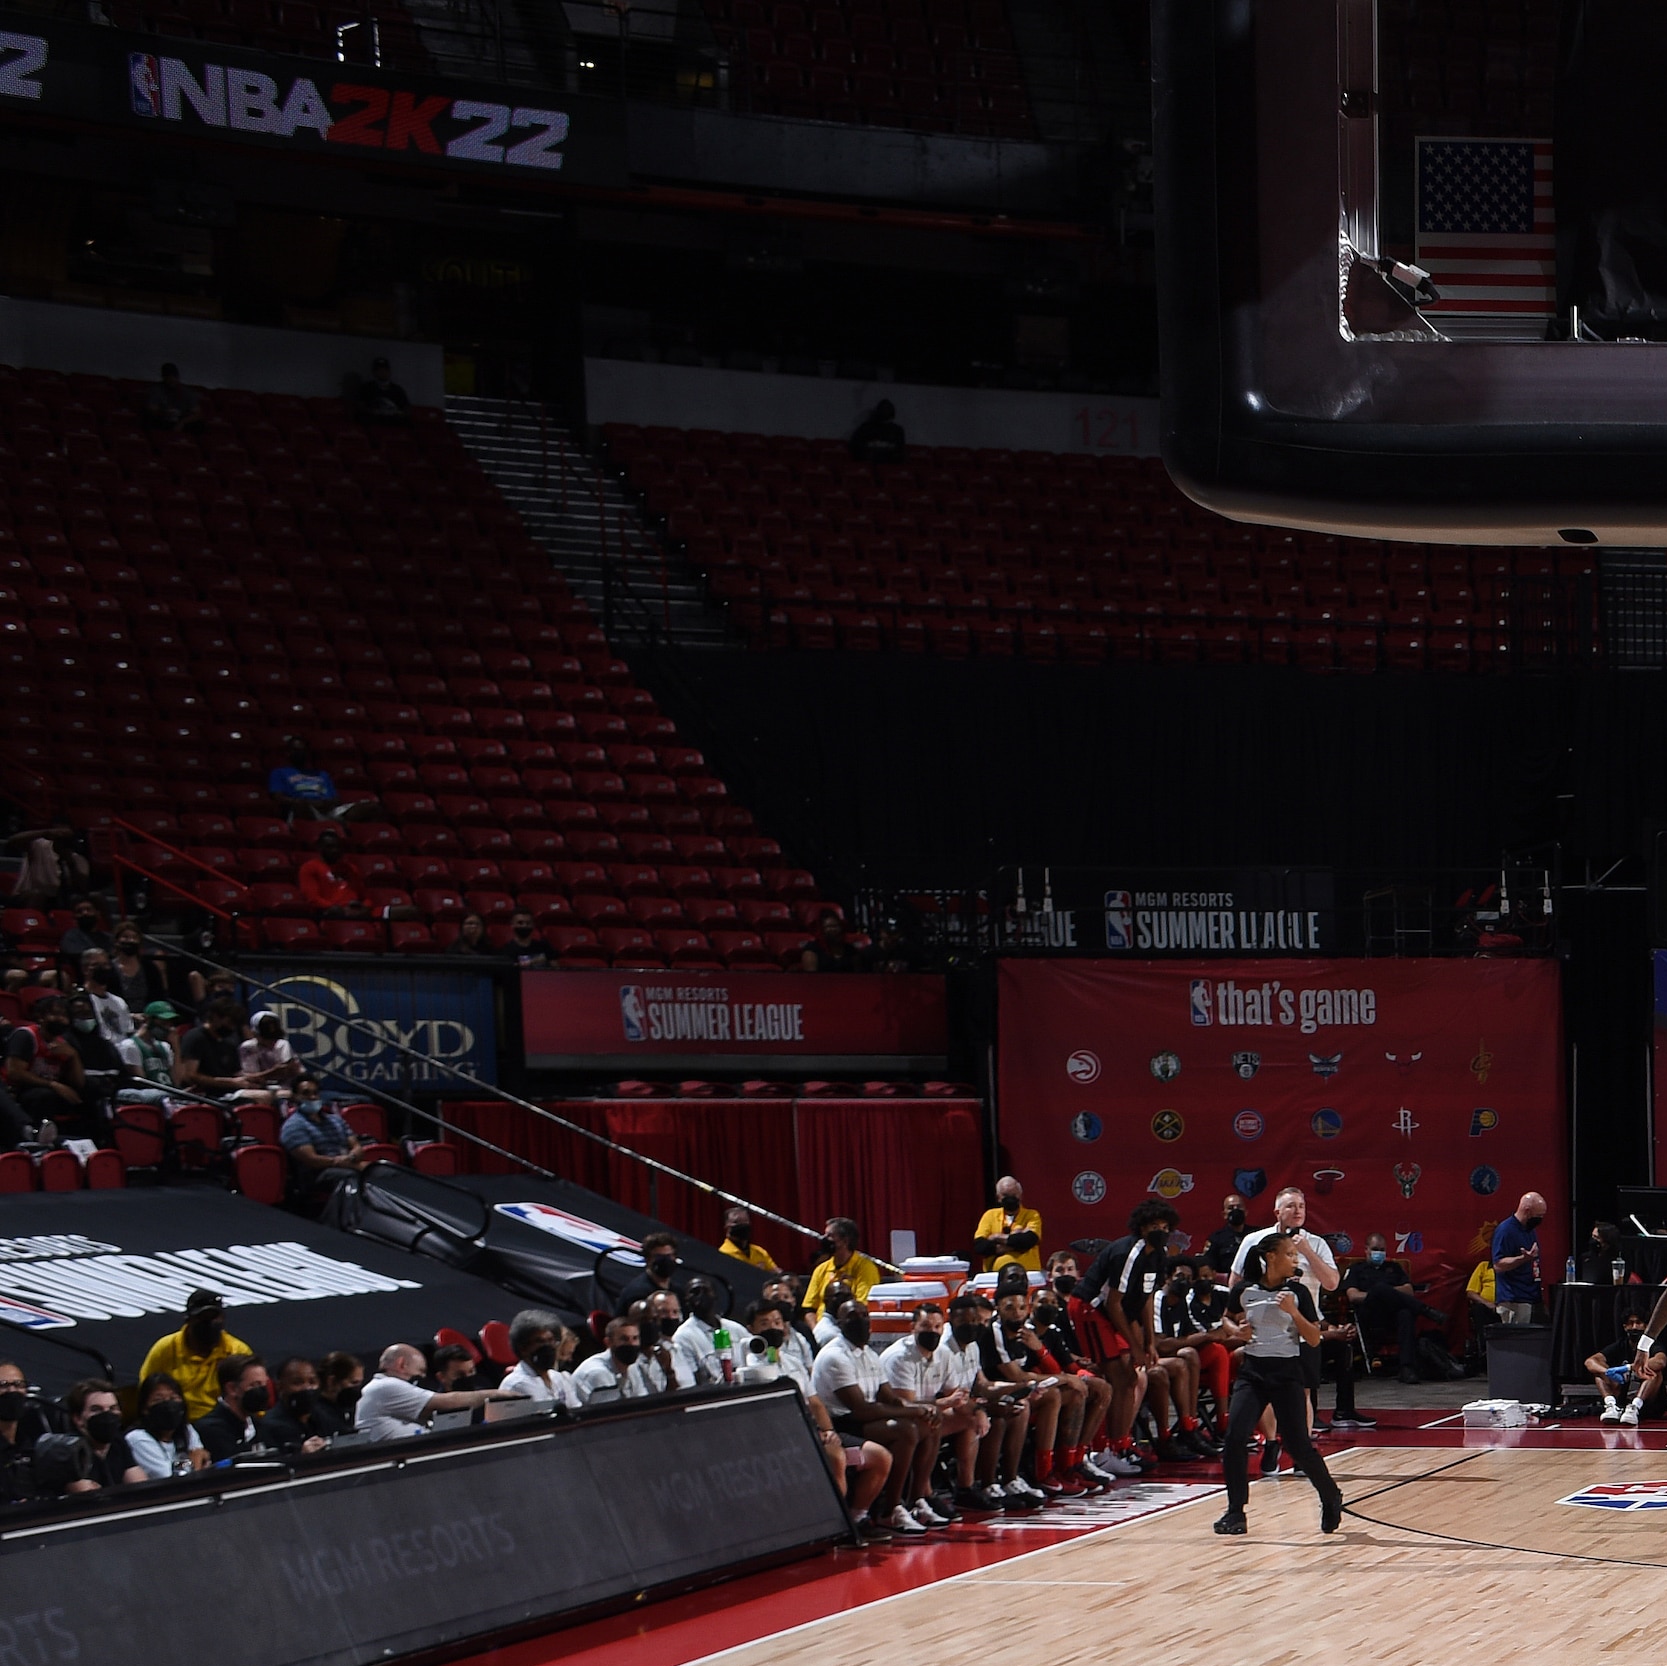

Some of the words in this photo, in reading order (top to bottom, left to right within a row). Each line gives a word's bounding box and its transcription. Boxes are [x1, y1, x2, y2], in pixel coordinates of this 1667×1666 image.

[1076, 406, 1140, 448] 121
[1134, 892, 1167, 907] MGM
[1172, 892, 1234, 908] RESORTS
[1136, 910, 1236, 950] SUMMER
[648, 1003, 731, 1041] SUMMER
[734, 1003, 805, 1041] LEAGUE
[1217, 981, 1296, 1027] that's
[1299, 988, 1377, 1034] game
[1394, 1231, 1423, 1255] 76
